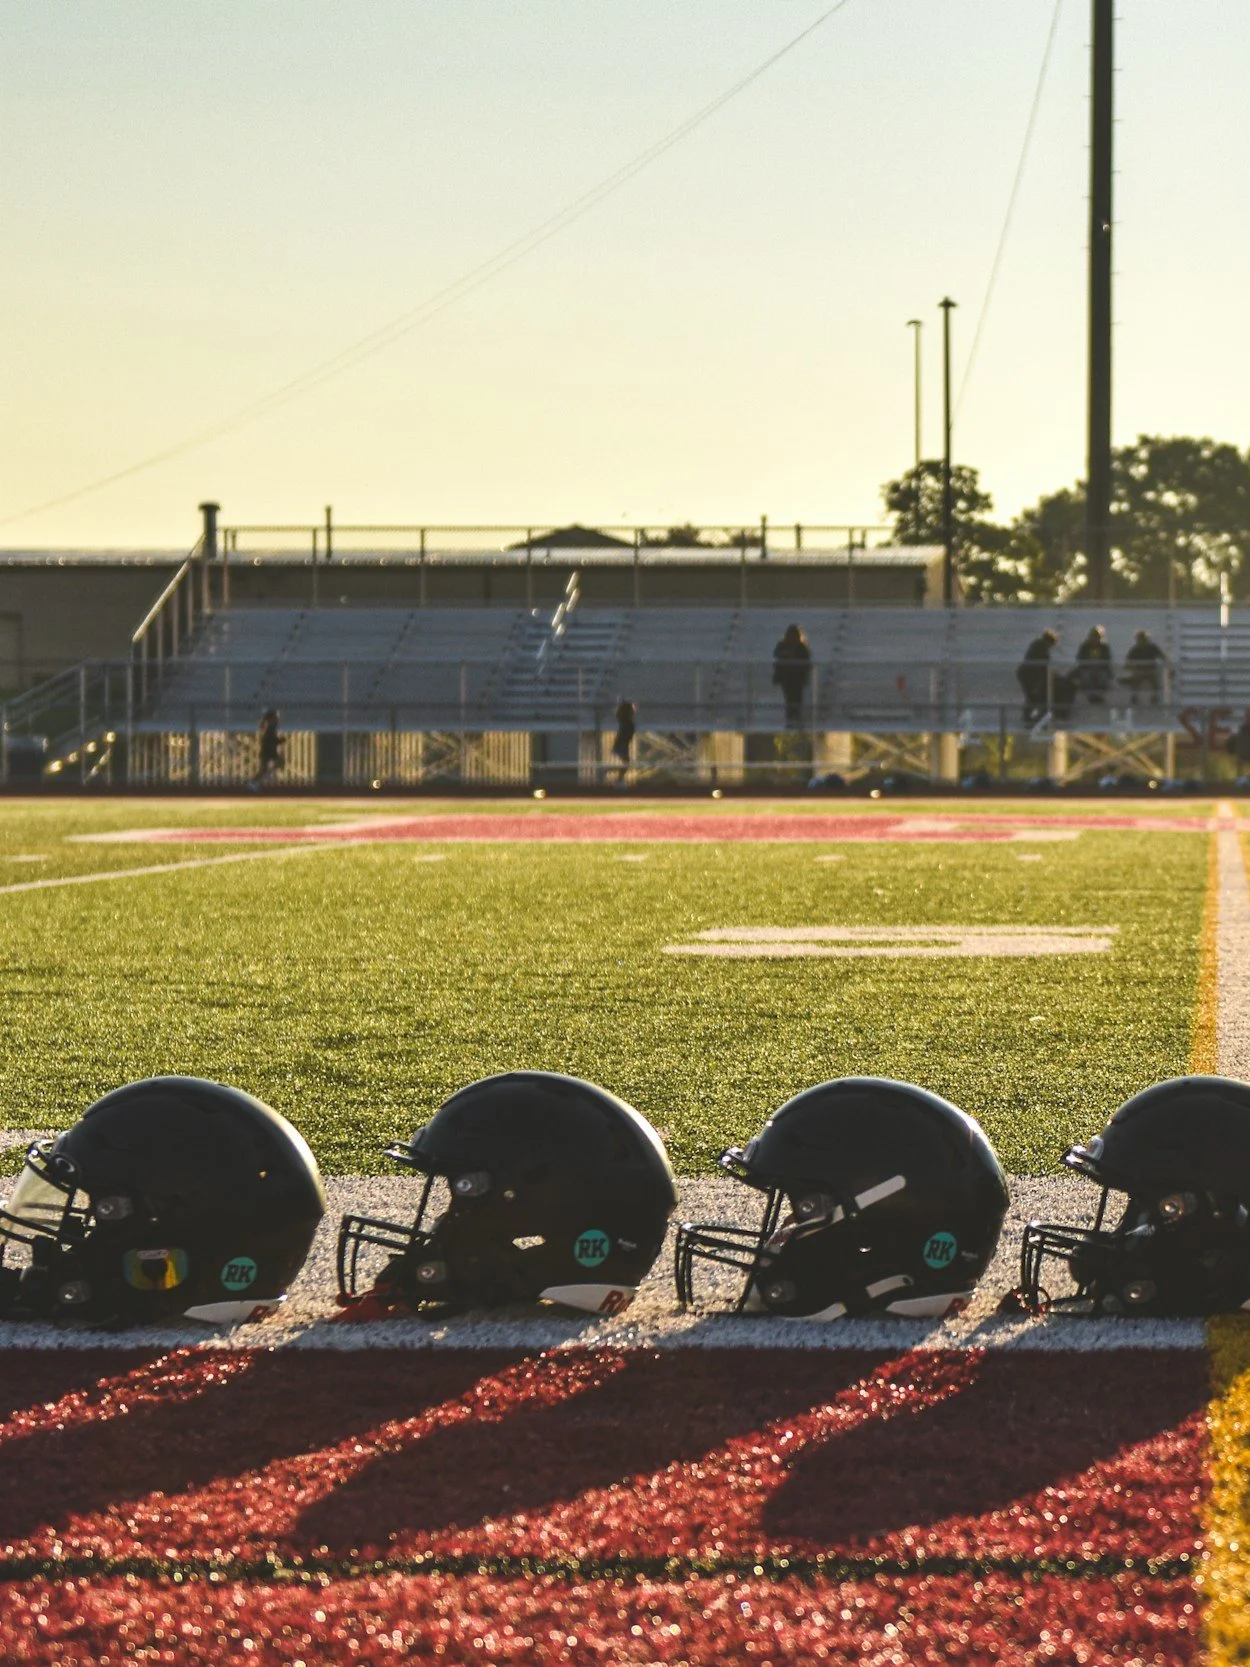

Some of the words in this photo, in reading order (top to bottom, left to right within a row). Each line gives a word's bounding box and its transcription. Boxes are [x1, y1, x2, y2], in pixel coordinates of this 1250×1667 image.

[578, 1238, 606, 1259] RK
[925, 1239, 954, 1261] RK
[224, 1263, 254, 1284] RK
